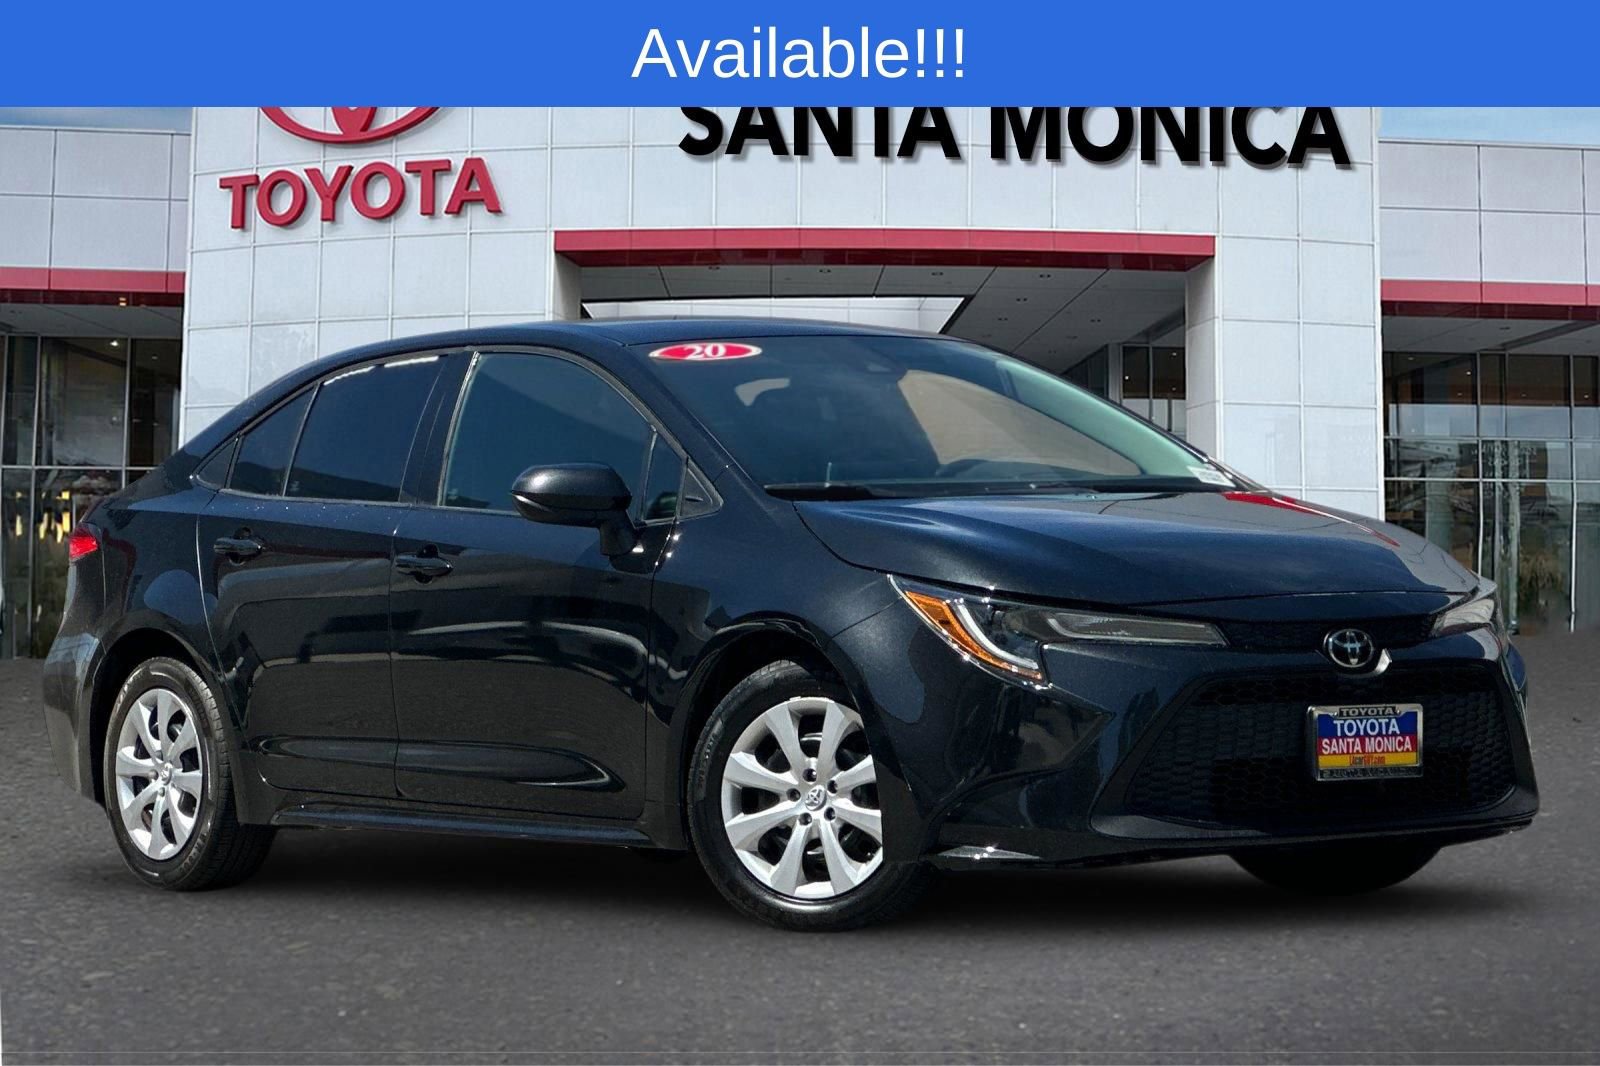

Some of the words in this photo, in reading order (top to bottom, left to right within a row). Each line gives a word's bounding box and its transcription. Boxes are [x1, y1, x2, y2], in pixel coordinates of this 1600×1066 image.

[990, 107, 1352, 166] MONICA
[219, 157, 503, 229] TOYOTA
[683, 344, 726, 360] 20
[1341, 707, 1394, 717] TOYOTA
[1333, 719, 1400, 736] TOYOTA
[1322, 738, 1362, 755] SANTA
[1365, 736, 1412, 753] MONICA
